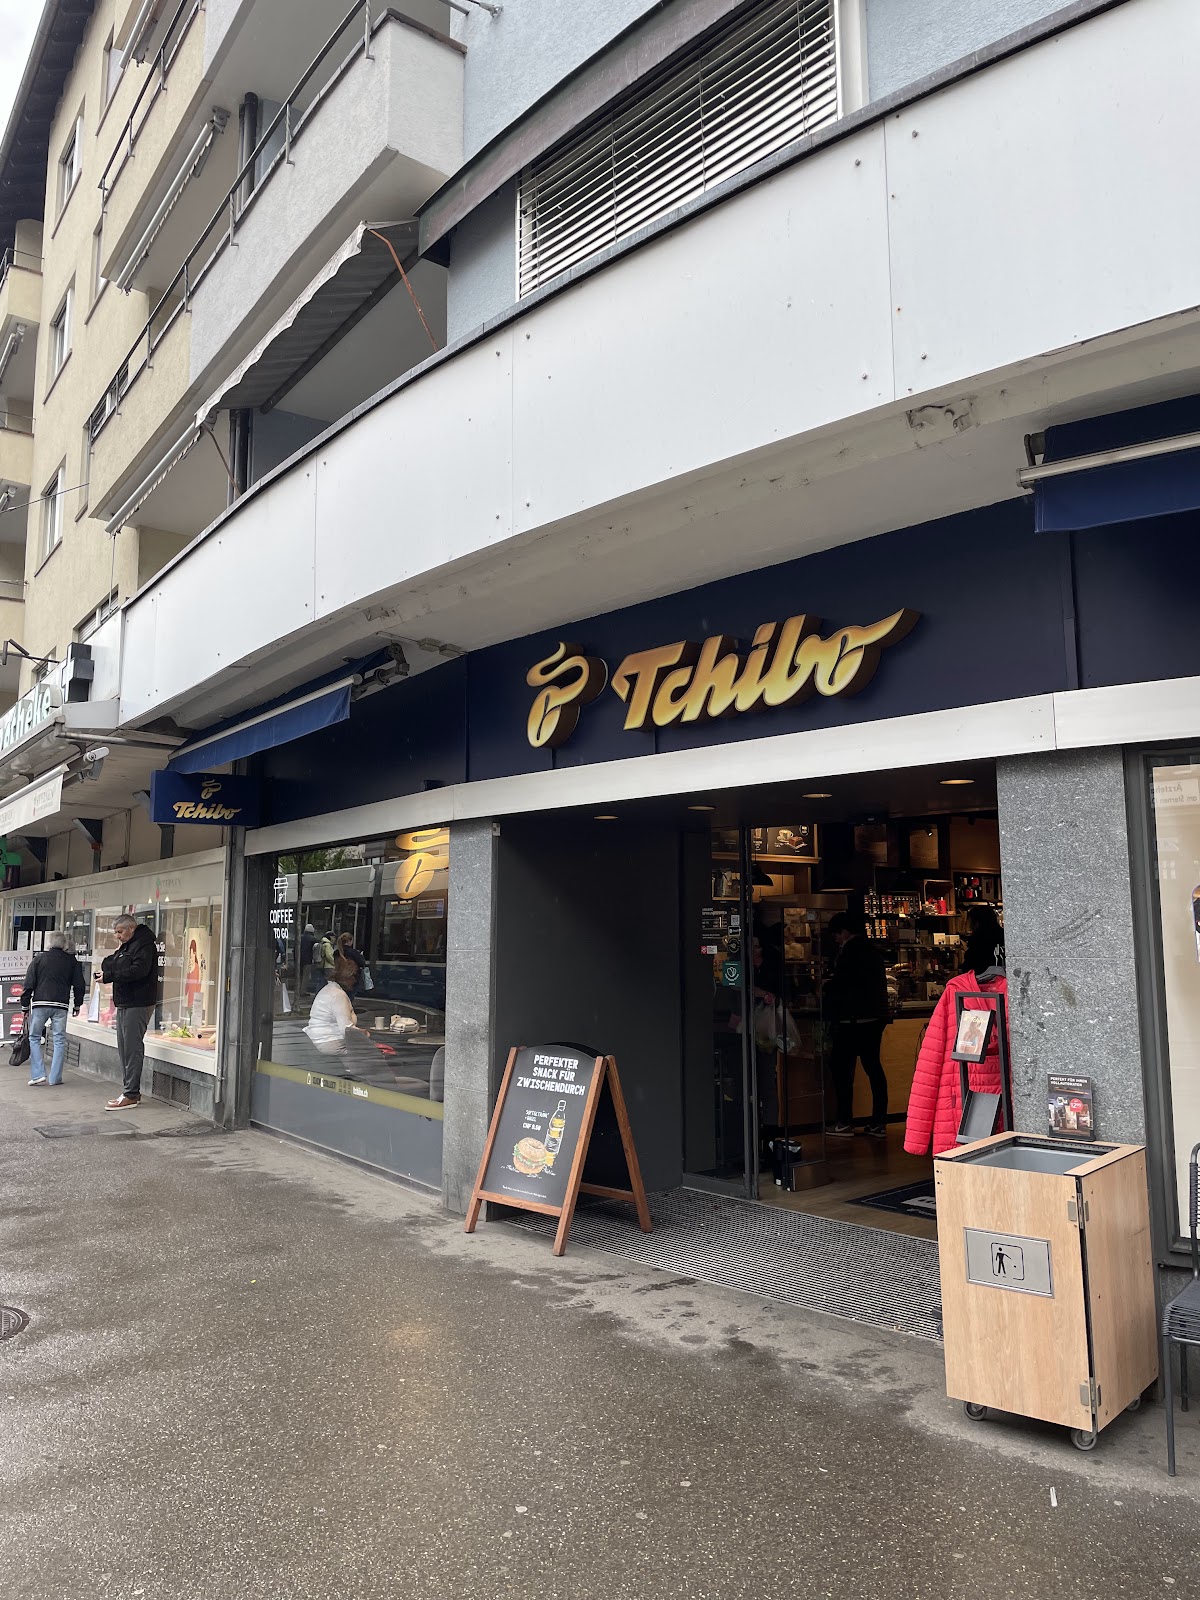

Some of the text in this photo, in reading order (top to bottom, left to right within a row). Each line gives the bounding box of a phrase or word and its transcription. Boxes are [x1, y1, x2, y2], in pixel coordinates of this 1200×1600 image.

[611, 608, 906, 731] Tchibo
[172, 801, 242, 820] Tchibo
[269, 908, 294, 924] COFFEE
[273, 927, 289, 939] TO GO
[533, 1054, 579, 1070] PERFEKTER
[532, 1066, 576, 1082] SNACK FÜR
[516, 1076, 586, 1096] ZWISCHENDURCH
